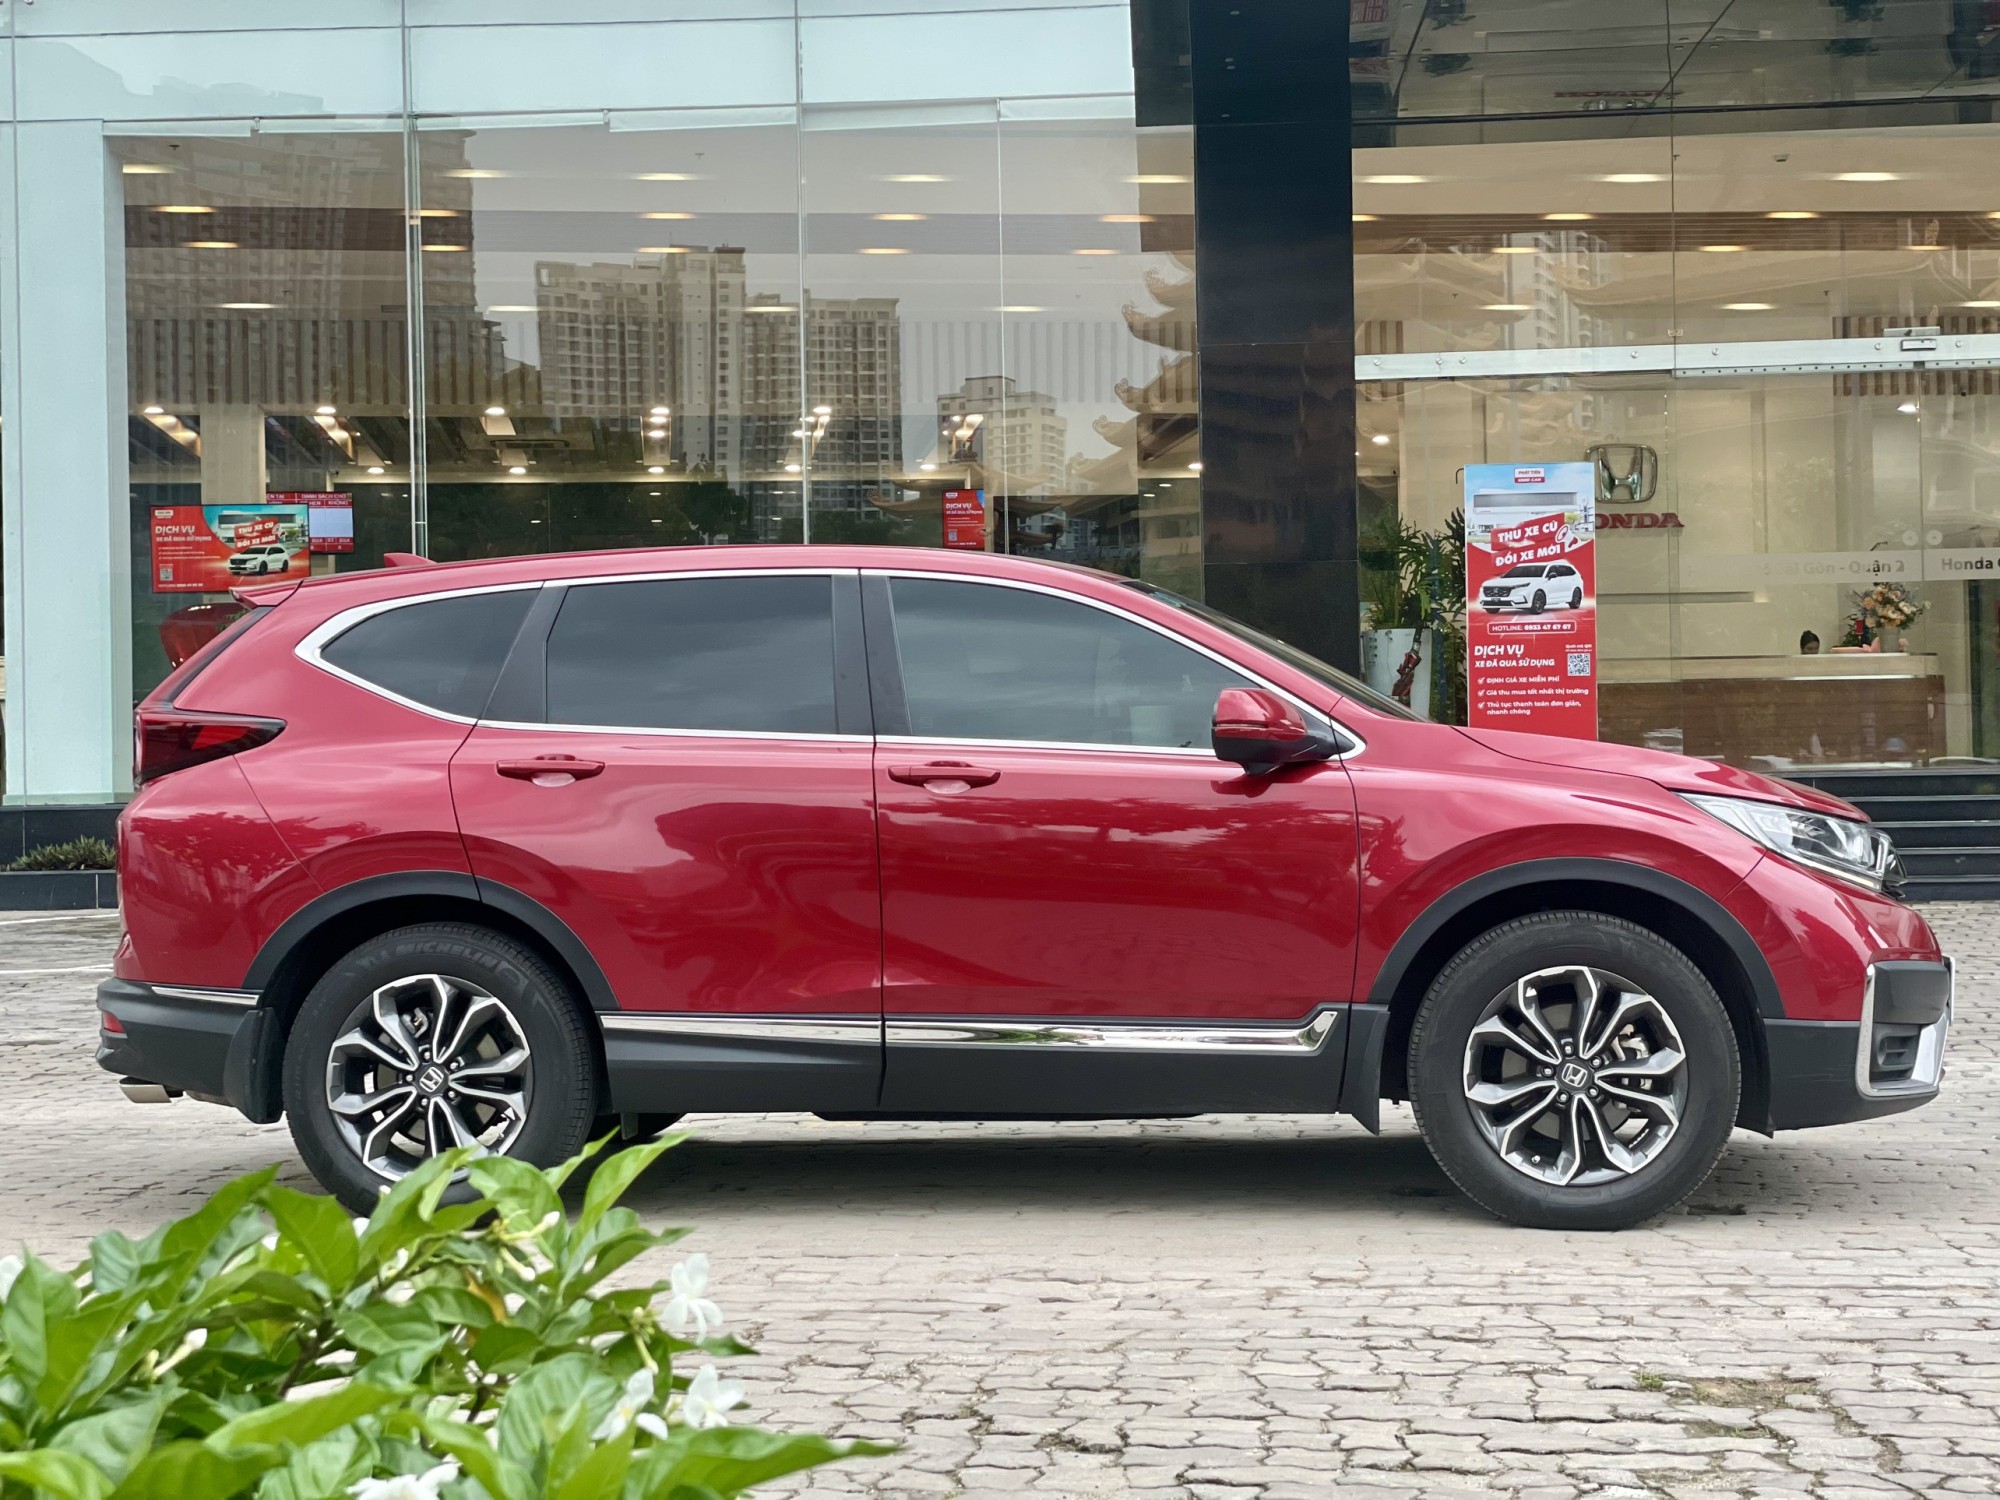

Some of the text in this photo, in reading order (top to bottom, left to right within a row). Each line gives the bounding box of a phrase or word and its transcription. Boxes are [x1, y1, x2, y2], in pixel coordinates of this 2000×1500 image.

[1595, 512, 1685, 530] ONDA
[155, 525, 195, 536] DỊCH VỤ
[1498, 529, 1522, 543] THU
[1524, 525, 1540, 538] XE
[1519, 549, 1535, 562] XE
[1941, 556, 1994, 570] Honda
[1474, 644, 1525, 658] DỊCH VỤ
[1475, 660, 1485, 668] XE
[1486, 658, 1498, 668] ĐÃ
[1499, 659, 1517, 667] QUA
[1530, 658, 1555, 669] DỤNG
[396, 942, 499, 969] MICHELIN
